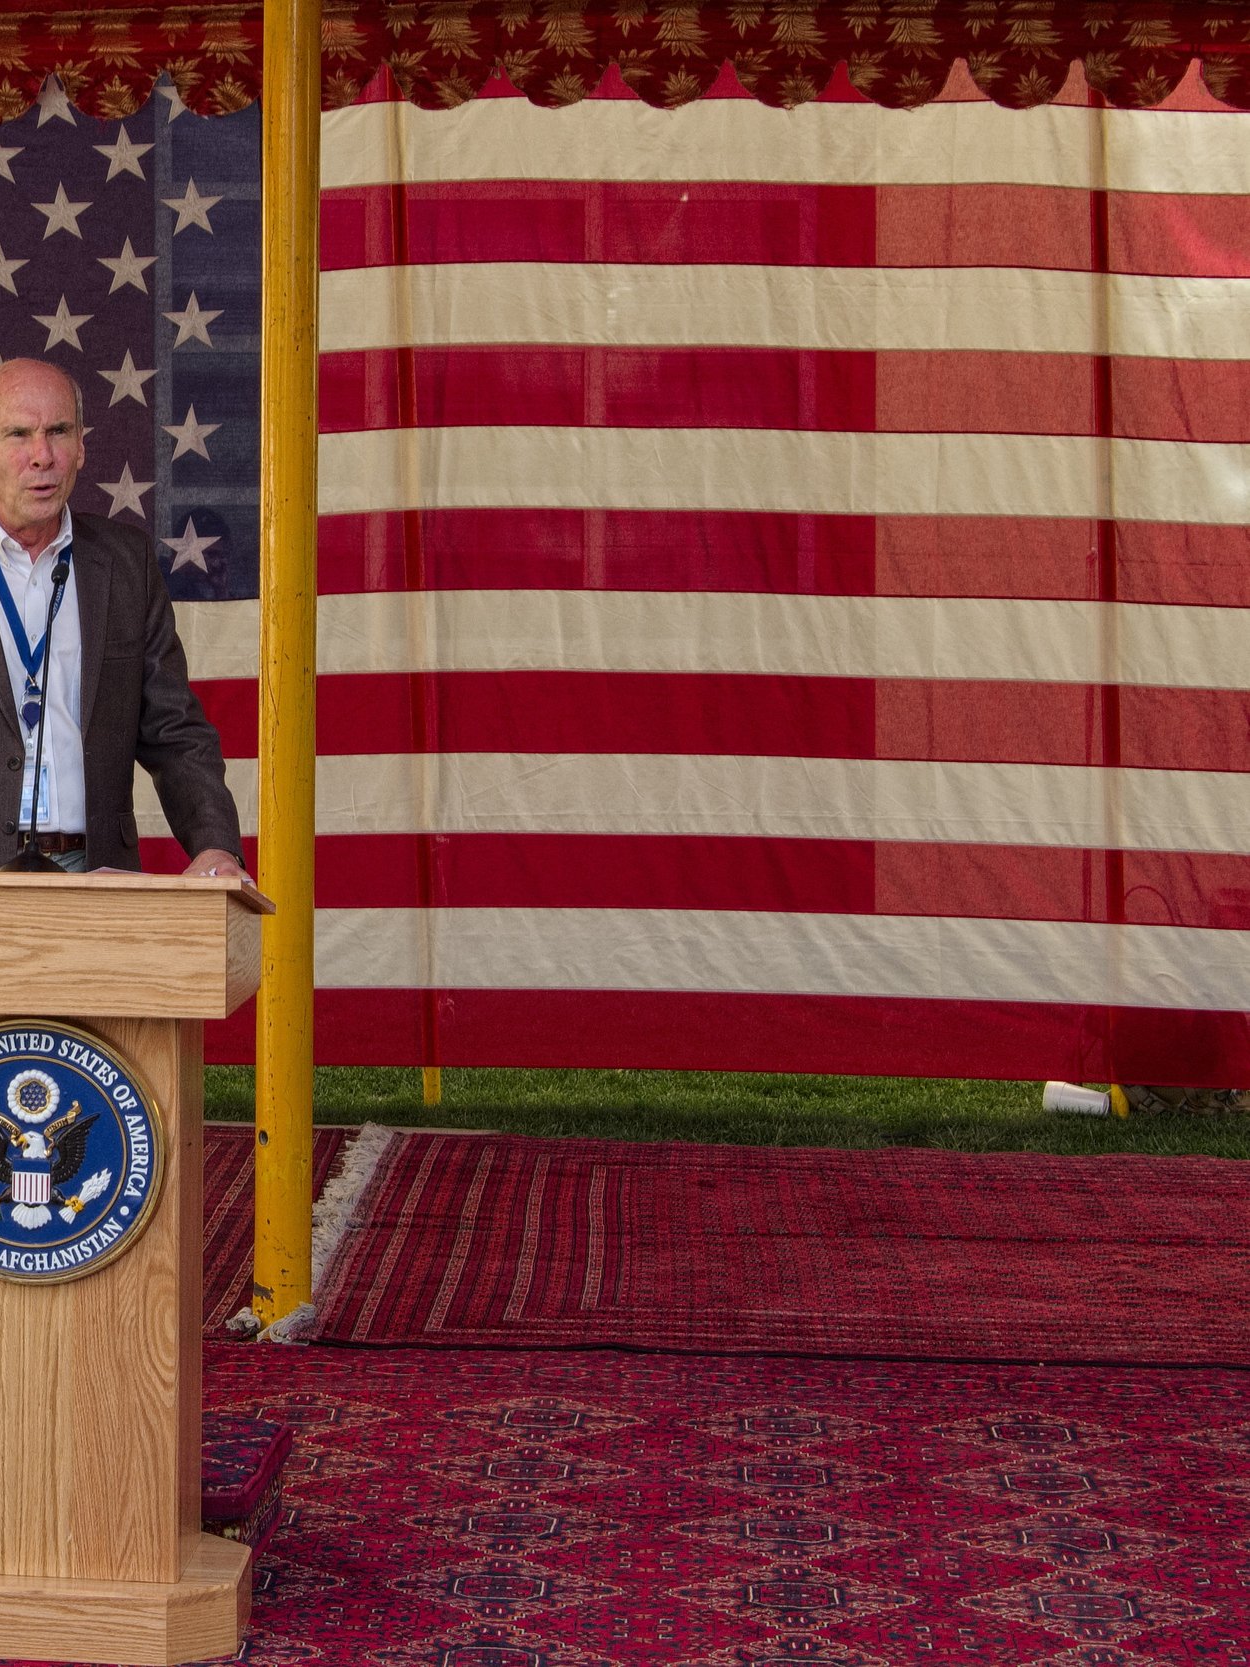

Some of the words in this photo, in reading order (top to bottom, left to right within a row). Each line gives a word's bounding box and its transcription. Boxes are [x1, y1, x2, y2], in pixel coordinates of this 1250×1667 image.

[58, 1040, 119, 1087] STATES
[113, 1084, 138, 1110] OF
[124, 1113, 150, 1199] AMERICA
